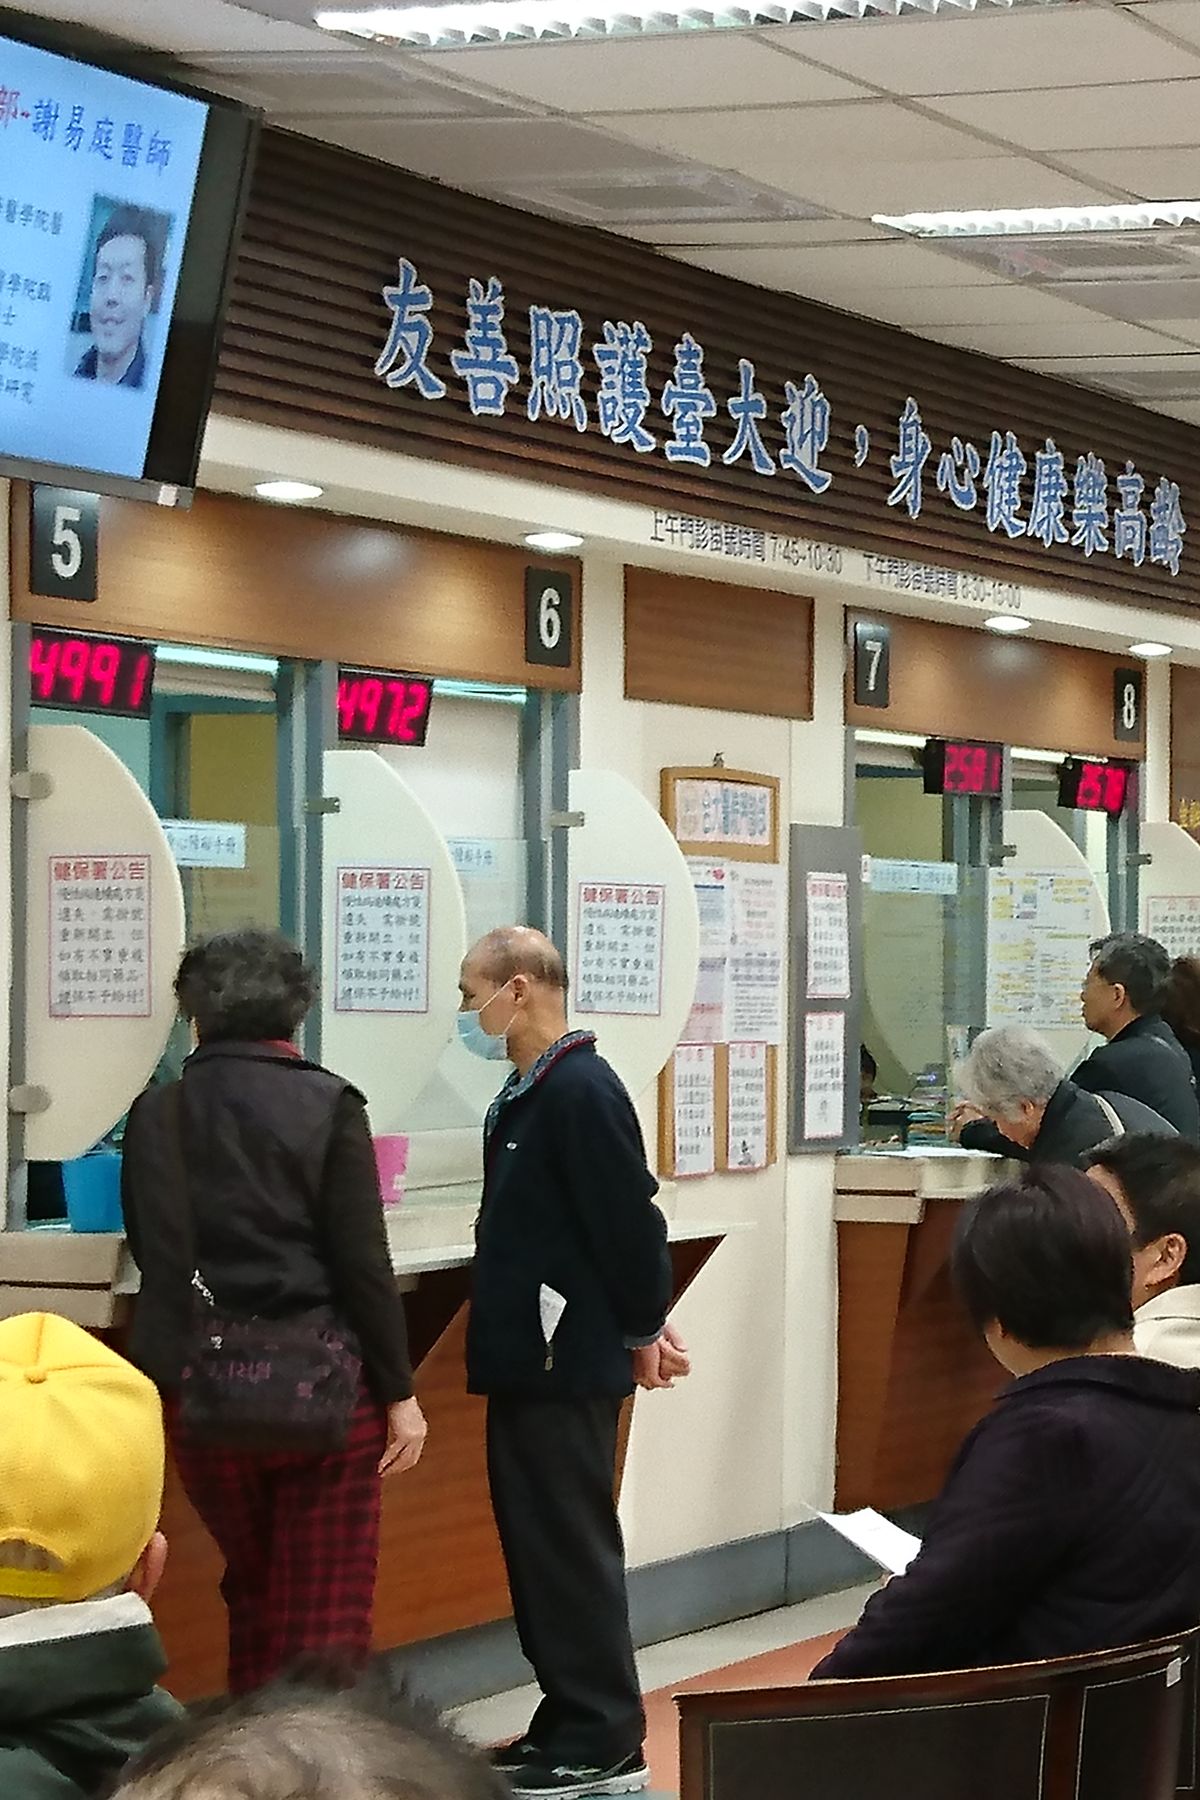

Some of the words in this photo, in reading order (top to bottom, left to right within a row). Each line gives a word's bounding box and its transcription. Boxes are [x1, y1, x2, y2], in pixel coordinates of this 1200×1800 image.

[51, 506, 83, 578] 5
[538, 587, 562, 650] 6
[29, 639, 149, 708] 4991
[864, 641, 883, 692] 7
[338, 679, 428, 741] 4972
[1122, 683, 1137, 730] 8
[54, 861, 146, 881] 健保署公告
[341, 872, 425, 890] 健保署公告
